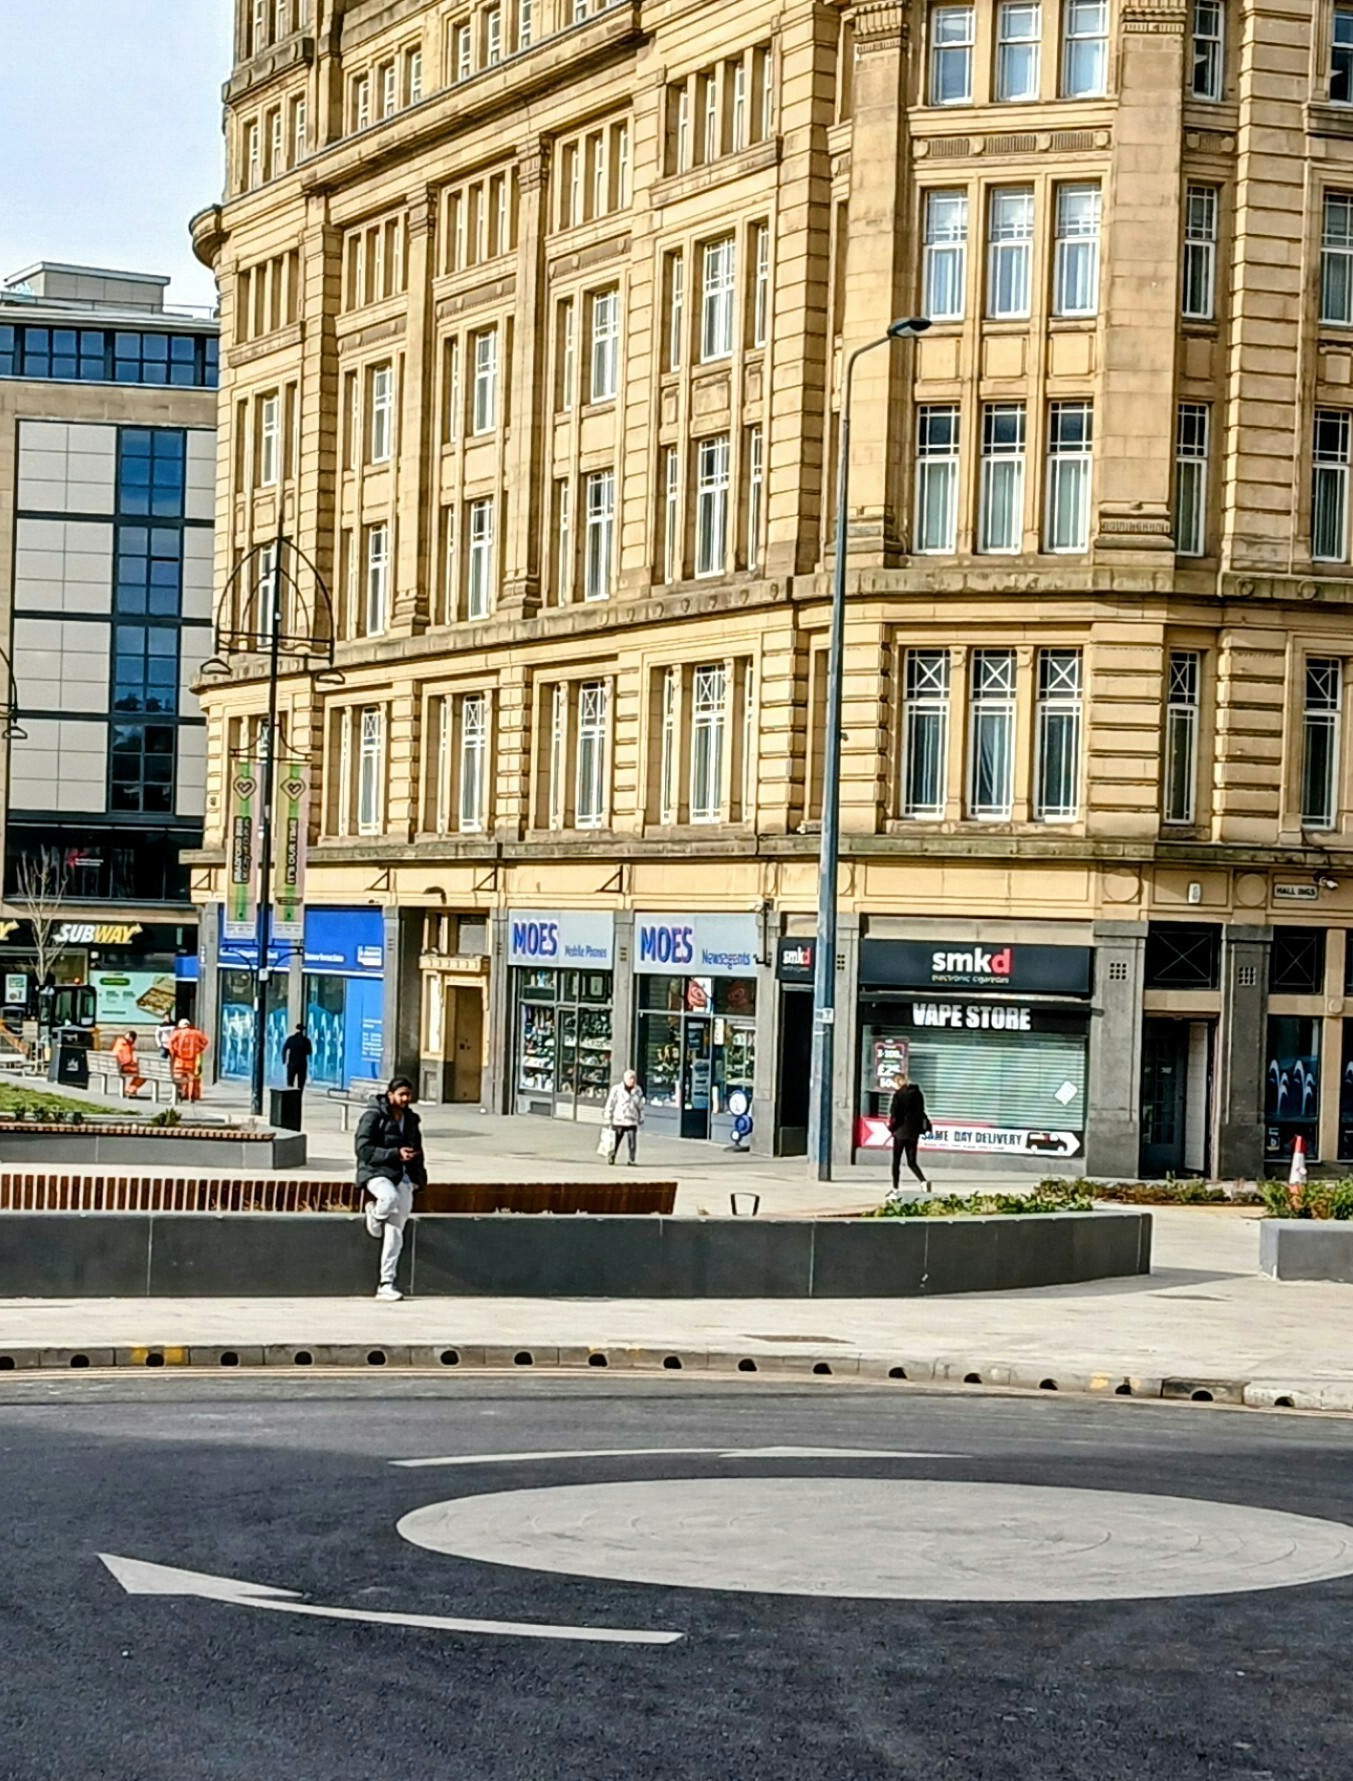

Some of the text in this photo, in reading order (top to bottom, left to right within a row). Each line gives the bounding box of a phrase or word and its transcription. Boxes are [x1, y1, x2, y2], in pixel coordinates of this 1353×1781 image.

[289, 820, 297, 842] TIME
[288, 843, 296, 865] OUR
[52, 922, 143, 944] SUBWAY
[513, 922, 558, 956] MOES
[640, 926, 693, 964] MOES
[932, 947, 1011, 975] smkd
[912, 1003, 1032, 1031] VAPE STORE
[954, 1130, 973, 1143] DAY
[975, 1132, 1023, 1145] DELIVERY
